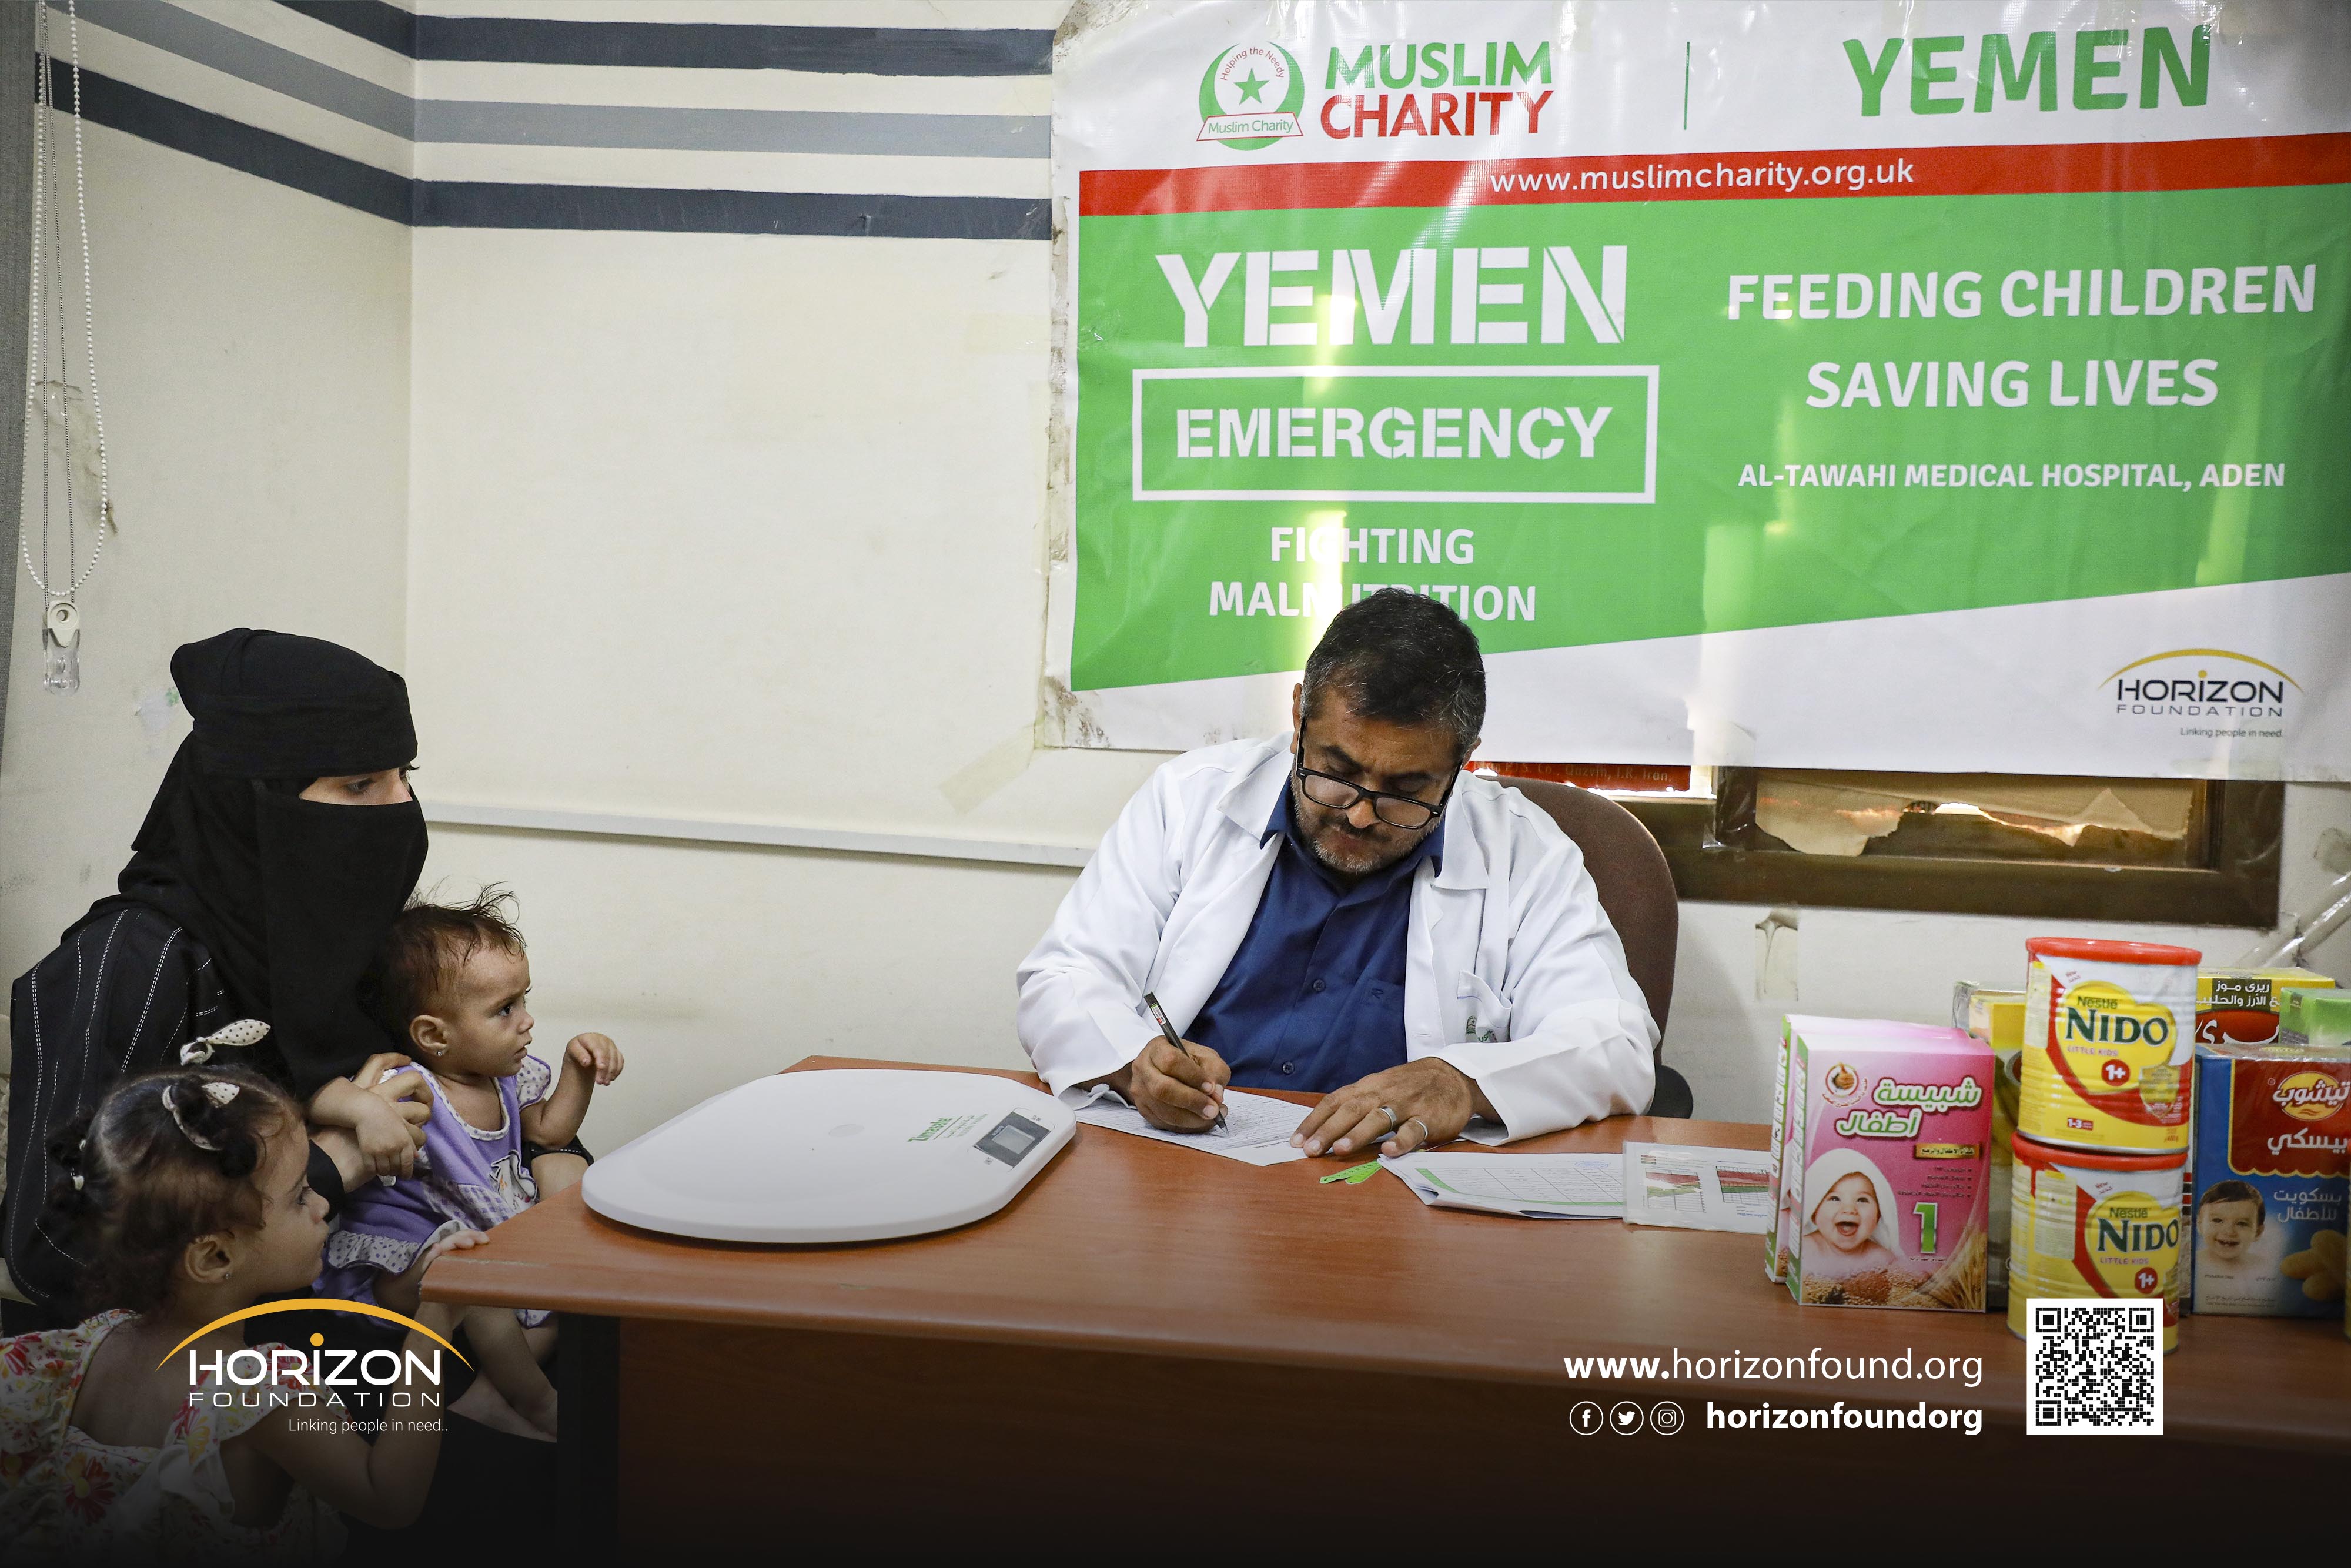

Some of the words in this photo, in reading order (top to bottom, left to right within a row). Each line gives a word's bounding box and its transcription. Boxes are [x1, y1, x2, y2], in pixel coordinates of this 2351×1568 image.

[1220, 51, 1247, 81] Helping
[1249, 47, 1264, 56] the
[1265, 51, 1285, 78] Needy
[1325, 41, 1553, 90] MUSLIM
[1842, 24, 2211, 118] YEMEN
[1208, 121, 1249, 134] Muslim
[1252, 119, 1293, 133] Charity
[1320, 90, 1554, 140] CHARITY
[1490, 158, 1915, 193] www.muslimcharity.org.uk
[1155, 245, 1627, 347] YEMEN
[1727, 270, 1982, 320] FEEDING
[1999, 263, 2316, 317] CHILDREN
[1805, 360, 2030, 408] SAVING
[2049, 359, 2218, 407] LIVES
[1176, 406, 1613, 460] EMERGENCY
[1738, 464, 1895, 487] AL-TAWAHI
[1905, 464, 2031, 487] MEDICAL
[2041, 464, 2192, 492] HOSPITAL,
[2199, 463, 2285, 487] ADEN
[1271, 527, 1474, 564] FIGHTING
[2118, 670, 2284, 704] HORIZON
[2117, 705, 2283, 717] FOUNDATION
[2181, 728, 2213, 738] Linking
[2216, 728, 2246, 739] people
[2249, 728, 2256, 737] in
[2216, 981, 2242, 992] موز
[2065, 1007, 2169, 1046] NIDO
[2068, 1046, 2094, 1055] LITTLE
[2098, 1048, 2119, 1057] KIDS
[2105, 1065, 2126, 1081] 1+
[1875, 1079, 1981, 1110] شبيسة
[2273, 1079, 2350, 1106] تيشوب
[1838, 1111, 1919, 1135] أطفال
[2273, 1188, 2342, 1205] بسكويت
[1914, 1202, 1938, 1253] 1
[2097, 1218, 2179, 1252] NIDO
[2138, 1272, 2154, 1288] 1+
